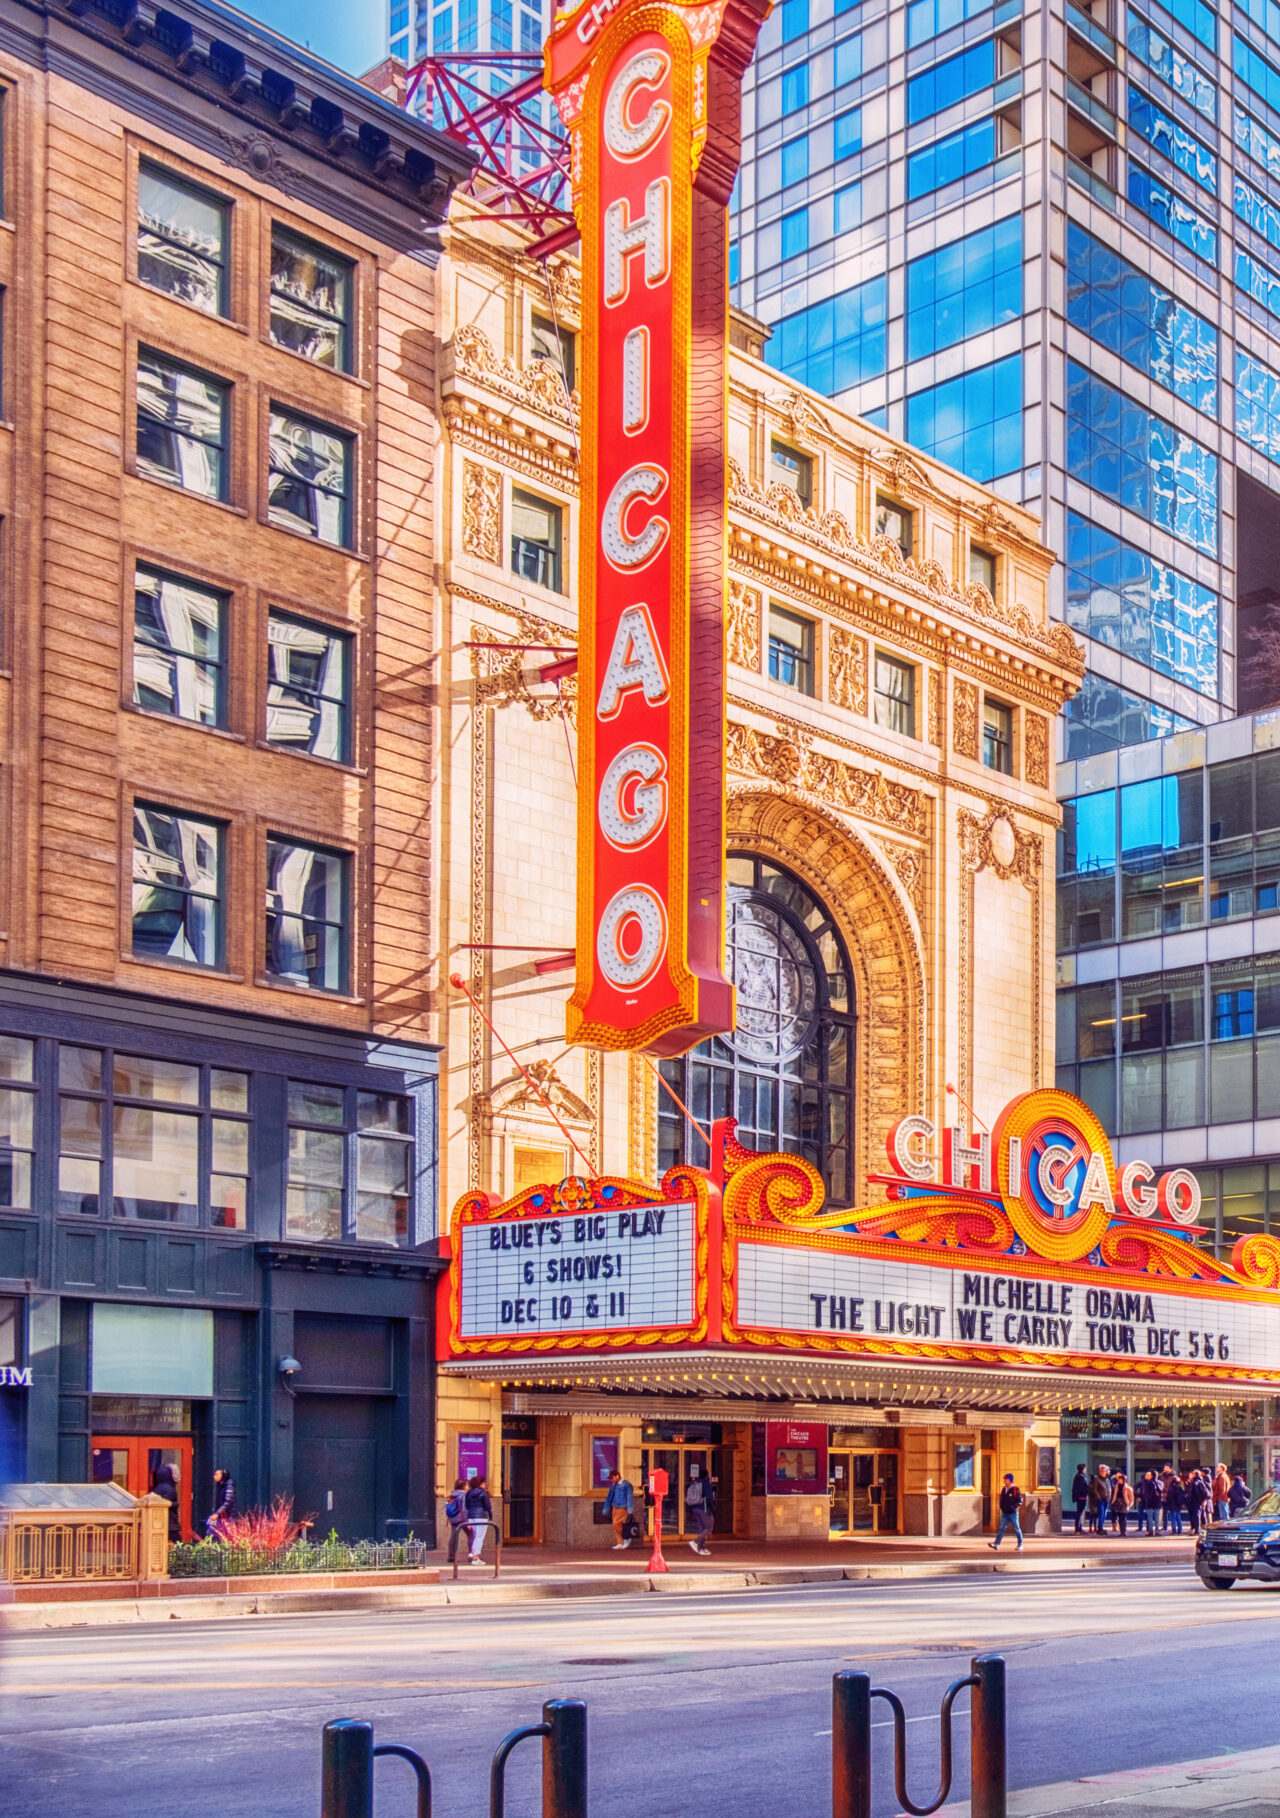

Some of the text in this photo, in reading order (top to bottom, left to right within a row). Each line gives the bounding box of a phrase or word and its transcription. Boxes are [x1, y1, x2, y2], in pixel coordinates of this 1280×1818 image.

[577, 0, 621, 43] CH
[596, 46, 674, 993] CHICAGO
[888, 1114, 1202, 1225] CHICAGO
[490, 1209, 666, 1250] BLUEY'S BIG PLAY
[523, 1253, 622, 1285] 6 SHOWS!
[501, 1291, 625, 1324] DEC 10 & 11
[963, 1273, 1156, 1323] MICHELLE OBAMA
[810, 1293, 864, 1331] THE
[874, 1299, 946, 1338] LIGHT
[957, 1307, 993, 1342] WE
[1003, 1312, 1073, 1348] CARRY
[1085, 1321, 1136, 1354] TOUR
[1147, 1326, 1181, 1358] DEC
